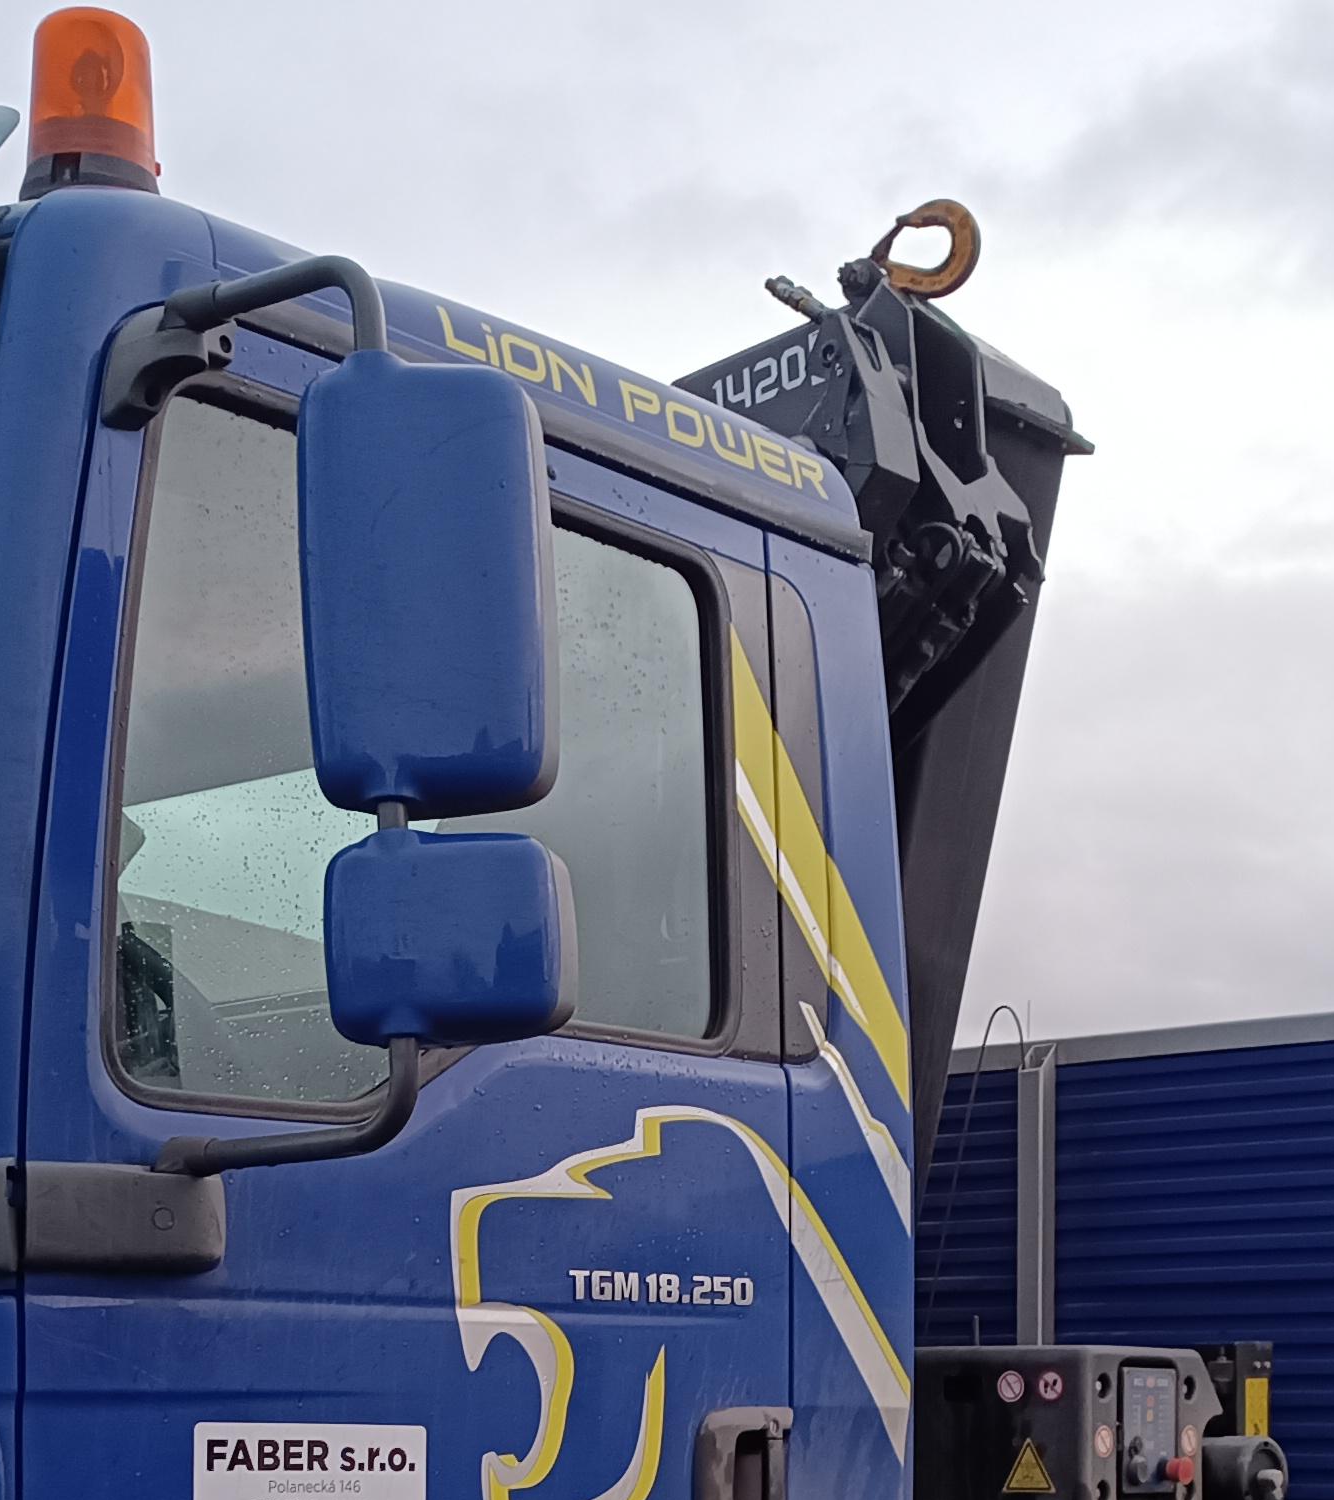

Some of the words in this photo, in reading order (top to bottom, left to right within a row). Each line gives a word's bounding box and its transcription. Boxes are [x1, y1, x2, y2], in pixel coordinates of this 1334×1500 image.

[618, 378, 830, 501] POWER
[569, 1269, 639, 1303] TGM
[645, 1272, 754, 1307] 18.250
[206, 1439, 329, 1472] FABER
[340, 1446, 416, 1472] s.r.o.
[268, 1479, 336, 1494] Polanecká
[339, 1479, 361, 1493] 146
